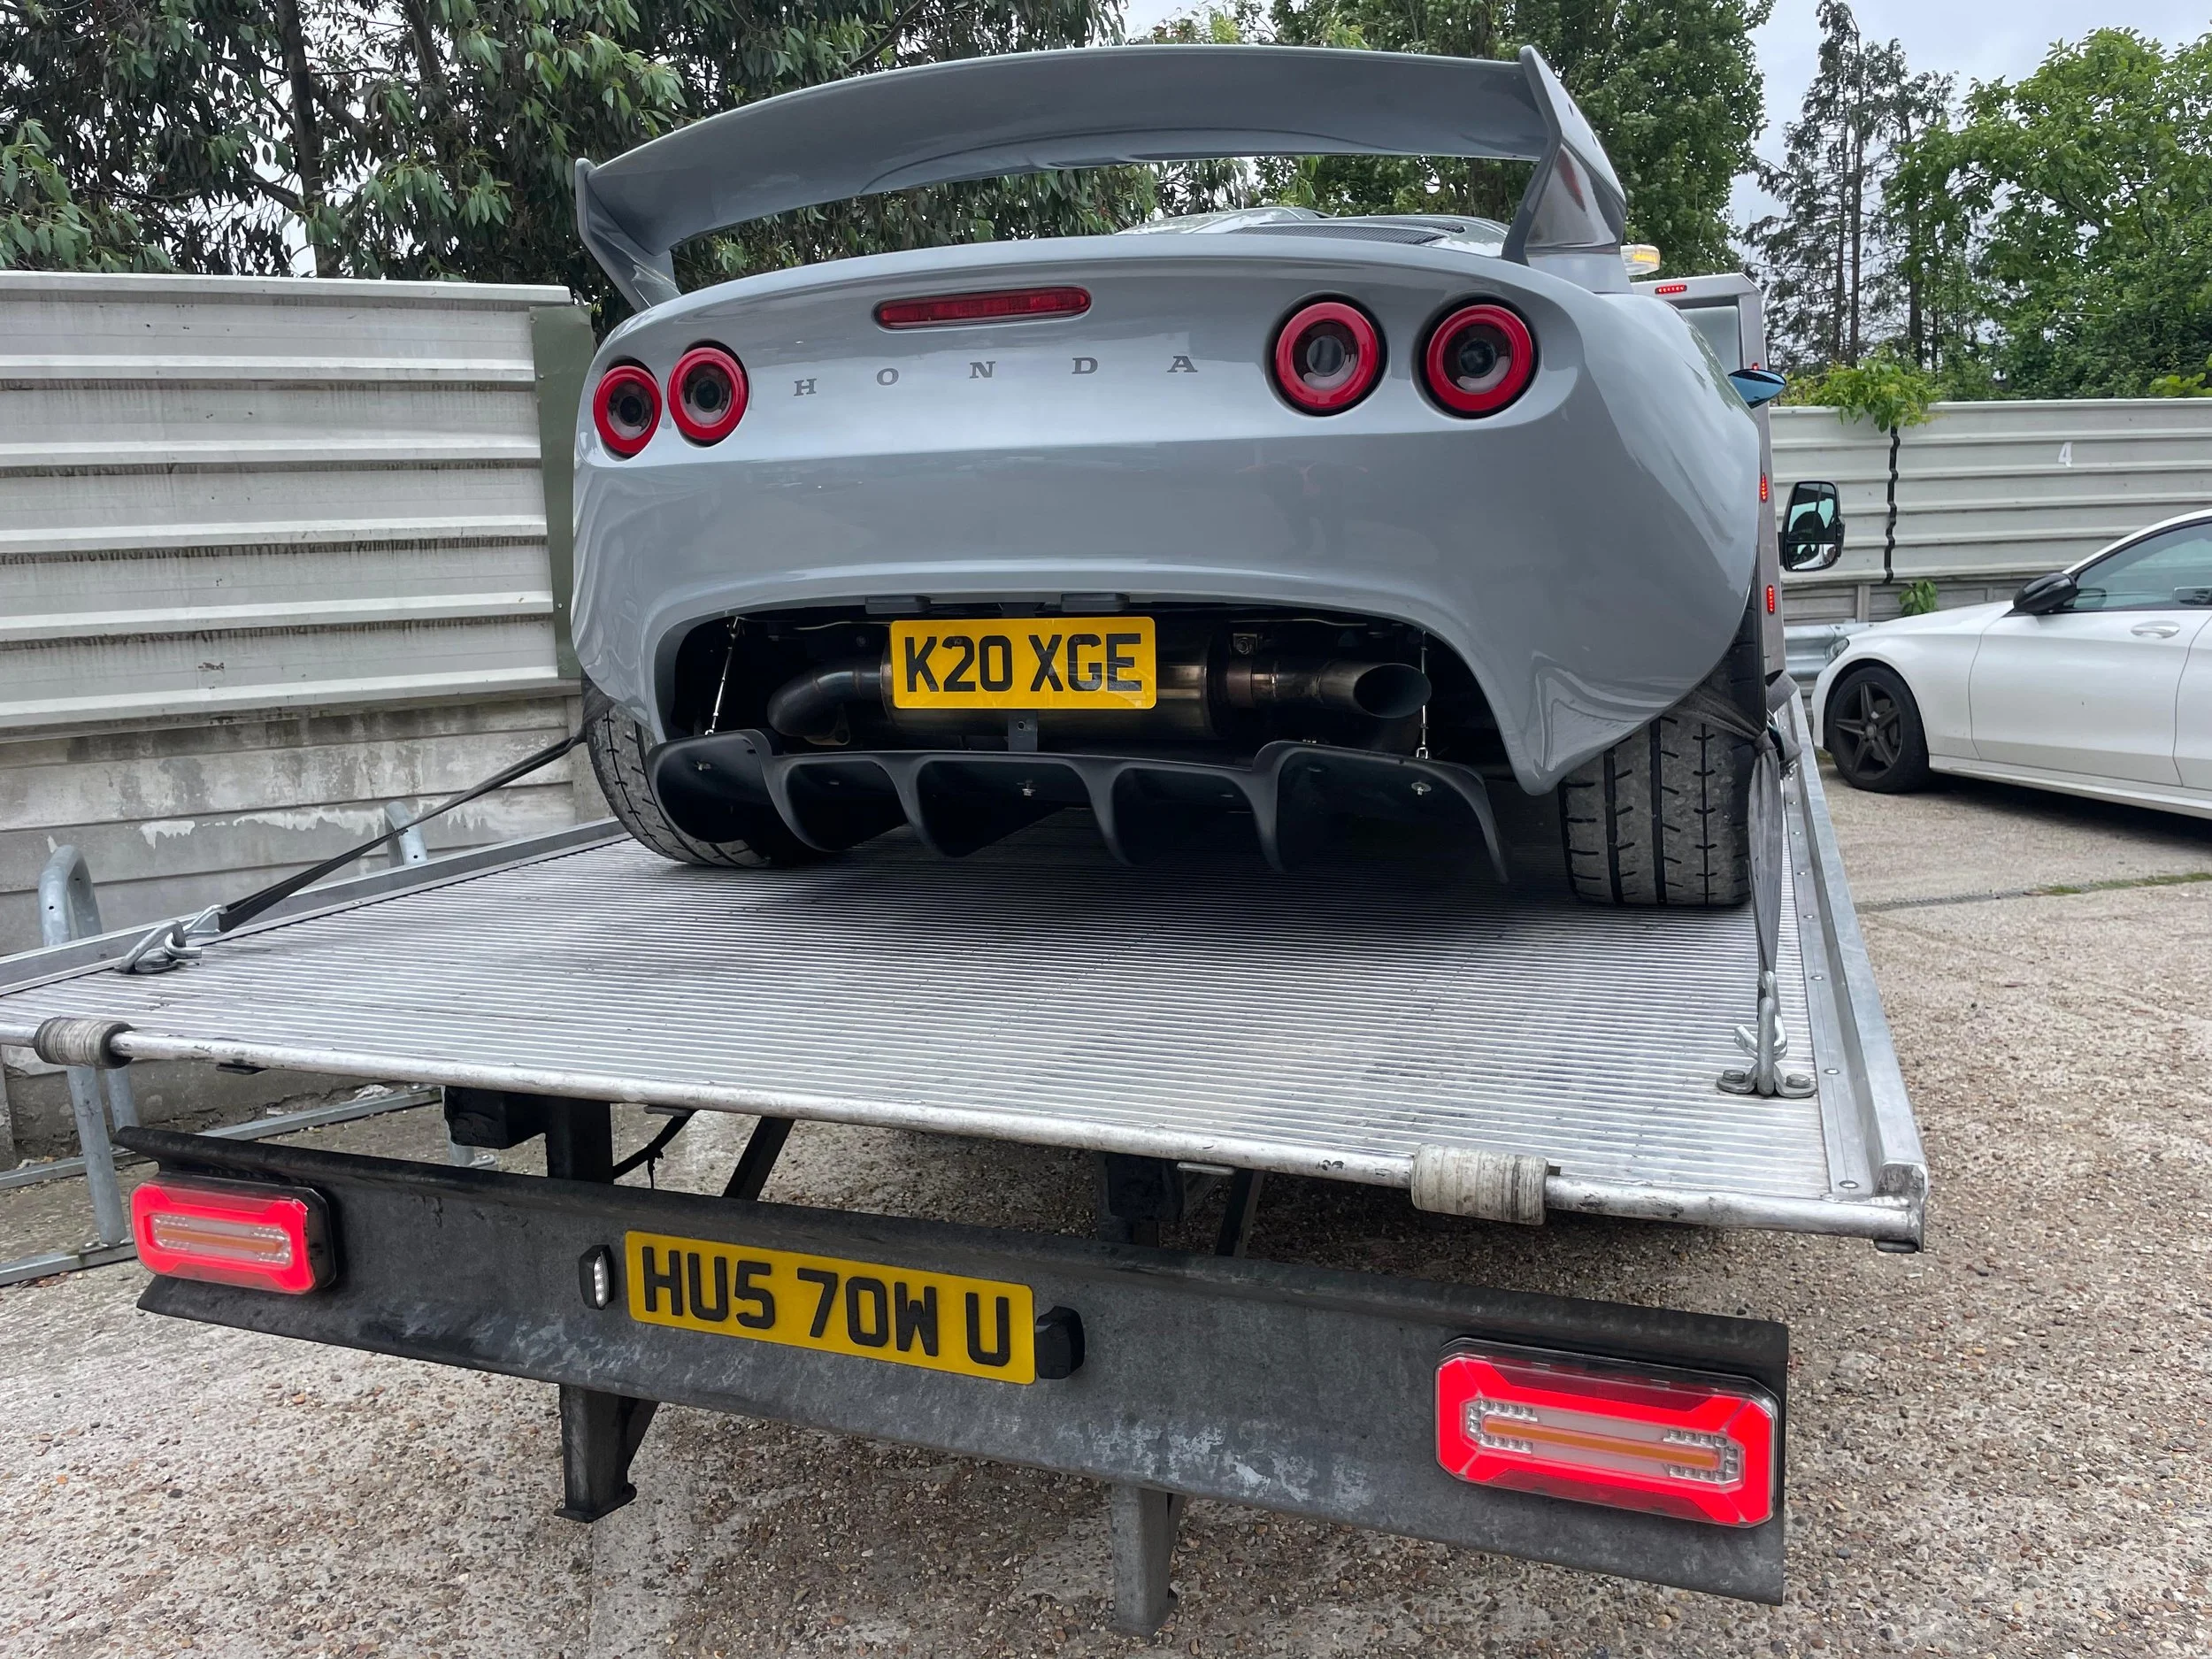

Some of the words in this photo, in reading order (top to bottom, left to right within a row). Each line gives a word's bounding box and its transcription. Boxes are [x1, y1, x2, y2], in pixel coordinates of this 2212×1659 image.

[793, 355, 1198, 396] HONDA
[2057, 442, 2073, 467] 4
[904, 635, 1013, 693] K20
[1028, 633, 1142, 692] XGE
[641, 1246, 775, 1329] HU5
